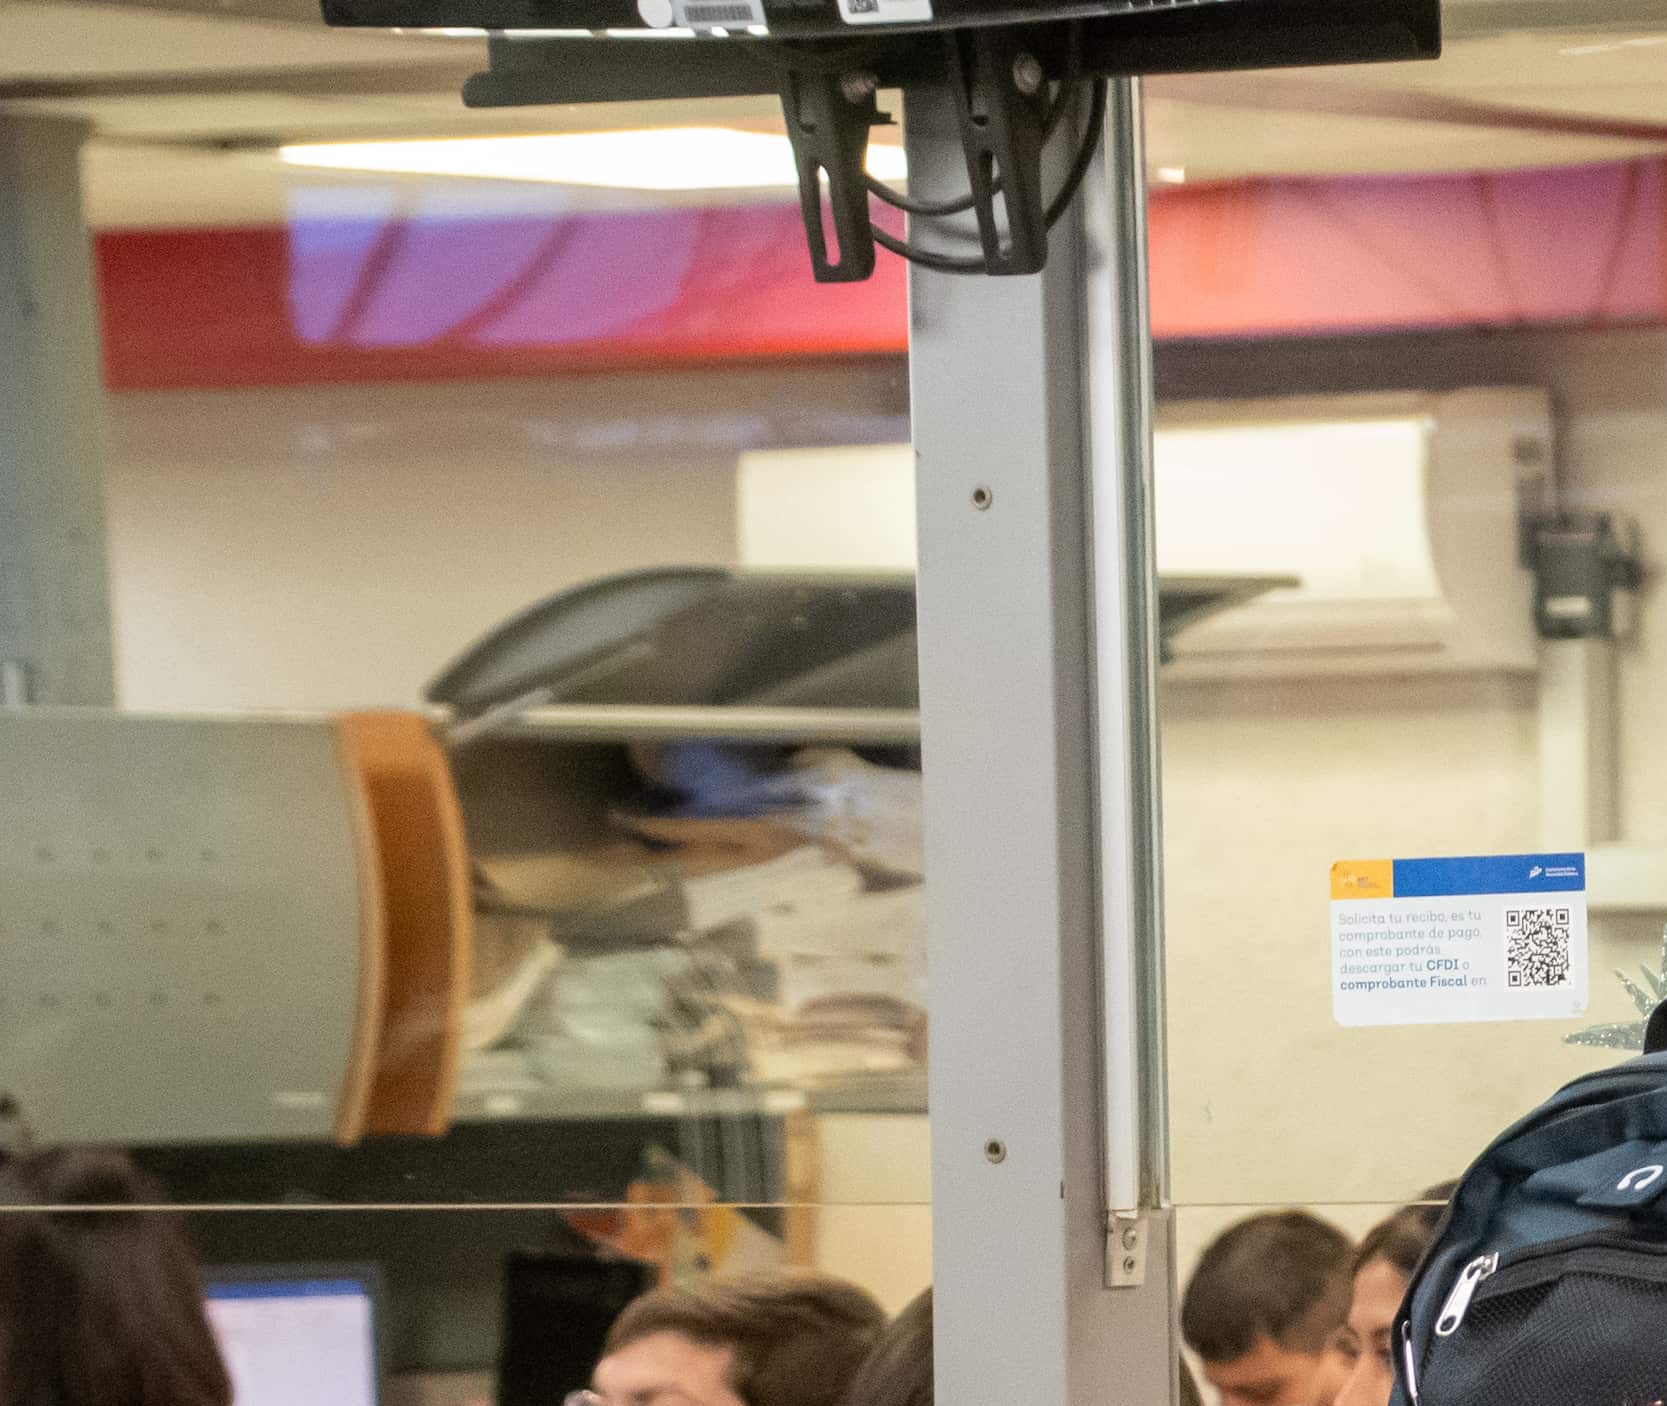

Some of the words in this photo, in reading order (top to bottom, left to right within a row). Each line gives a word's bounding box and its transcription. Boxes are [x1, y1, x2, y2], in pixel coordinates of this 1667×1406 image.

[1339, 913, 1385, 925] Solicita
[1390, 913, 1402, 924] tu
[1469, 910, 1482, 920] tu
[1339, 929, 1425, 943] comprobante
[1429, 928, 1444, 938] de
[1340, 948, 1362, 958] con
[1366, 946, 1392, 957] este
[1340, 963, 1405, 975] descargar
[1409, 962, 1422, 972] tu
[1426, 959, 1459, 971] CFDI
[1340, 977, 1426, 992] comprobante
[1430, 975, 1467, 987] Fiscal
